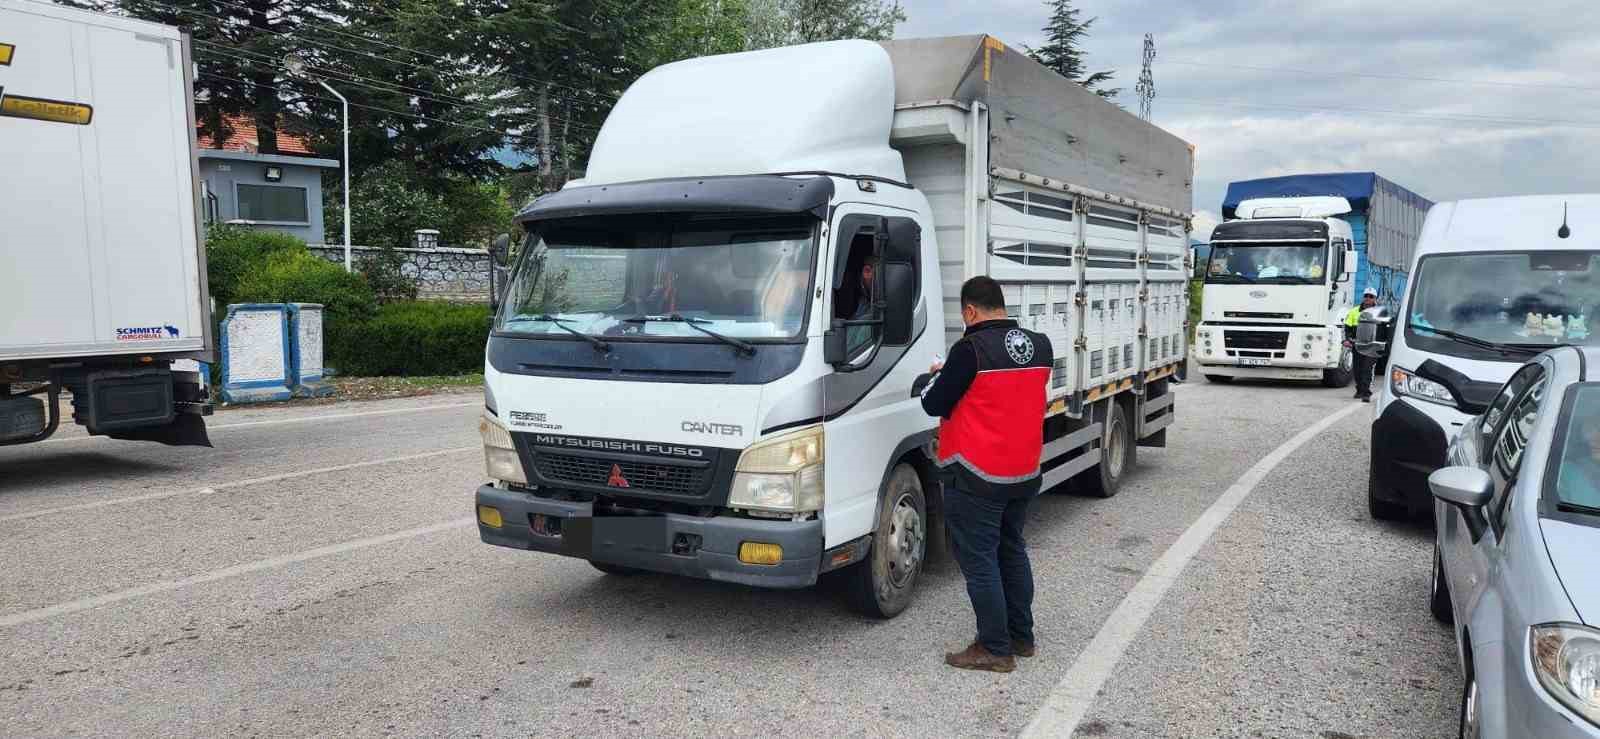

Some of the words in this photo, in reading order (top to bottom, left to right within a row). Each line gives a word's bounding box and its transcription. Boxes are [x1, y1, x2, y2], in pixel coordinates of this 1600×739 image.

[116, 327, 162, 335] SCHMITZ
[681, 421, 743, 436] CANTER
[536, 434, 641, 451] MITSUBISHI
[644, 444, 703, 457] FUSO
